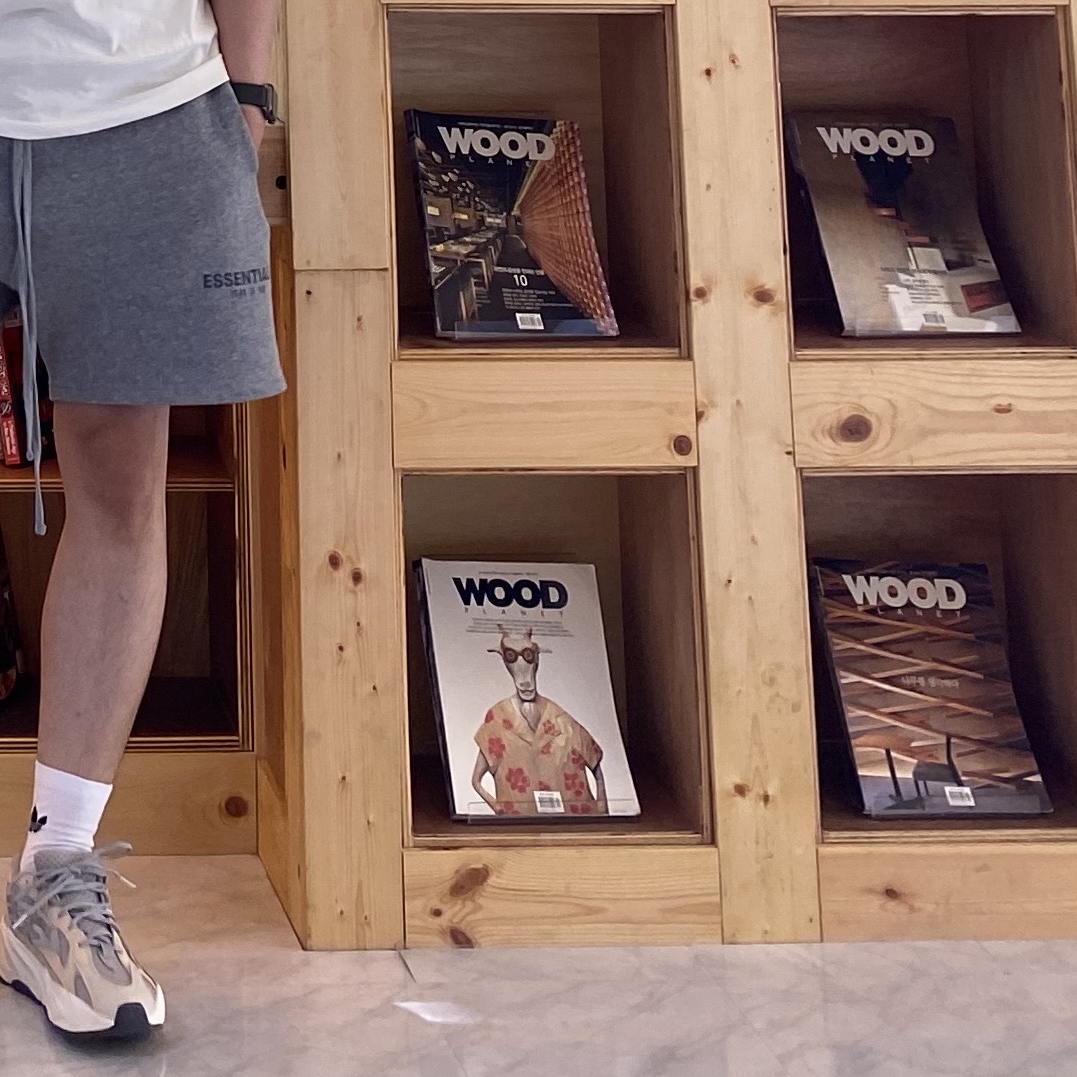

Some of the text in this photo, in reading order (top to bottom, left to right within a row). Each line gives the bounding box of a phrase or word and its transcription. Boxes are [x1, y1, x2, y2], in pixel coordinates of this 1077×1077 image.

[437, 125, 555, 161] WOOD
[816, 126, 936, 157] WOOD
[513, 273, 528, 287] 10
[452, 577, 568, 609] WOOD
[842, 574, 967, 610] WOOD
